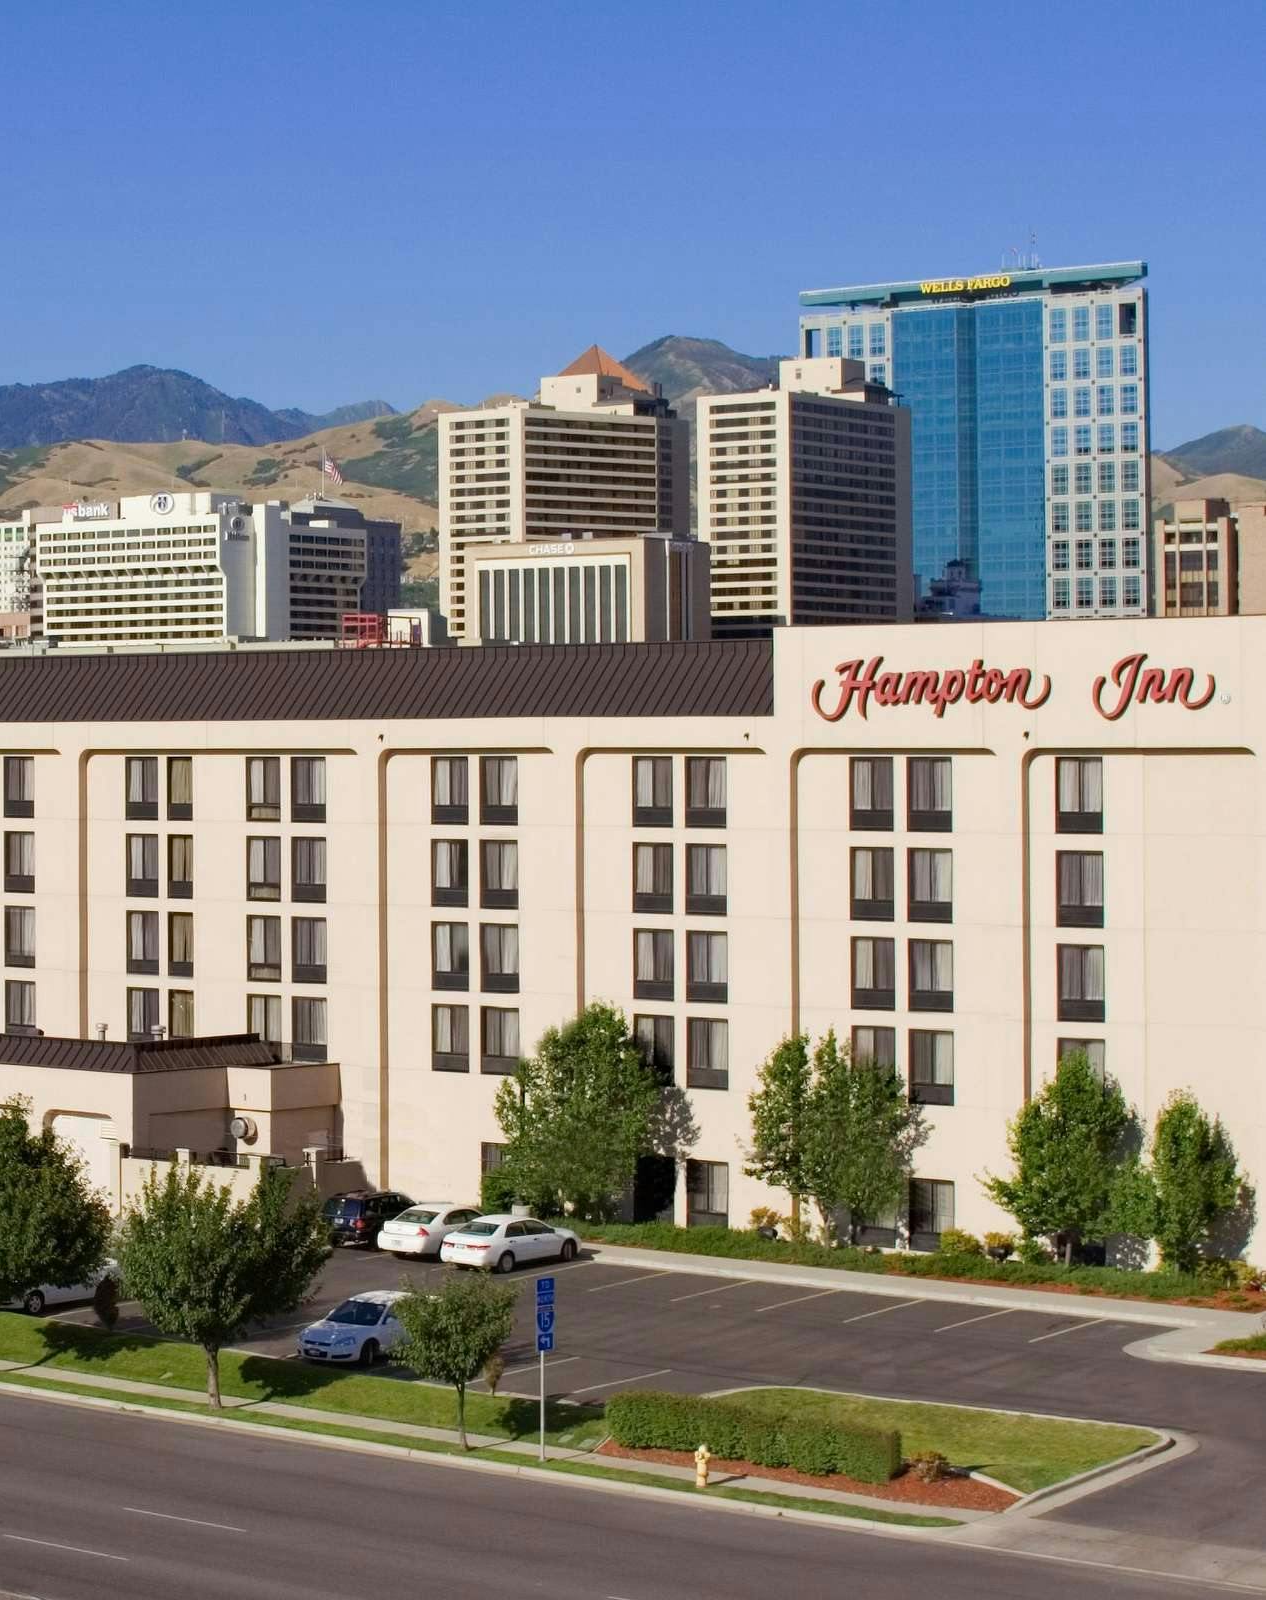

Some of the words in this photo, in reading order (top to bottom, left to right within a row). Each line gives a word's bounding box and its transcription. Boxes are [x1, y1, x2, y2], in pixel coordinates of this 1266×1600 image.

[920, 280, 964, 294] WELLS
[967, 276, 1011, 290] FARGO
[529, 544, 564, 555] CHASE
[811, 655, 1052, 723] Hampton
[1092, 653, 1215, 721] Inn
[540, 1312, 551, 1329] 15
